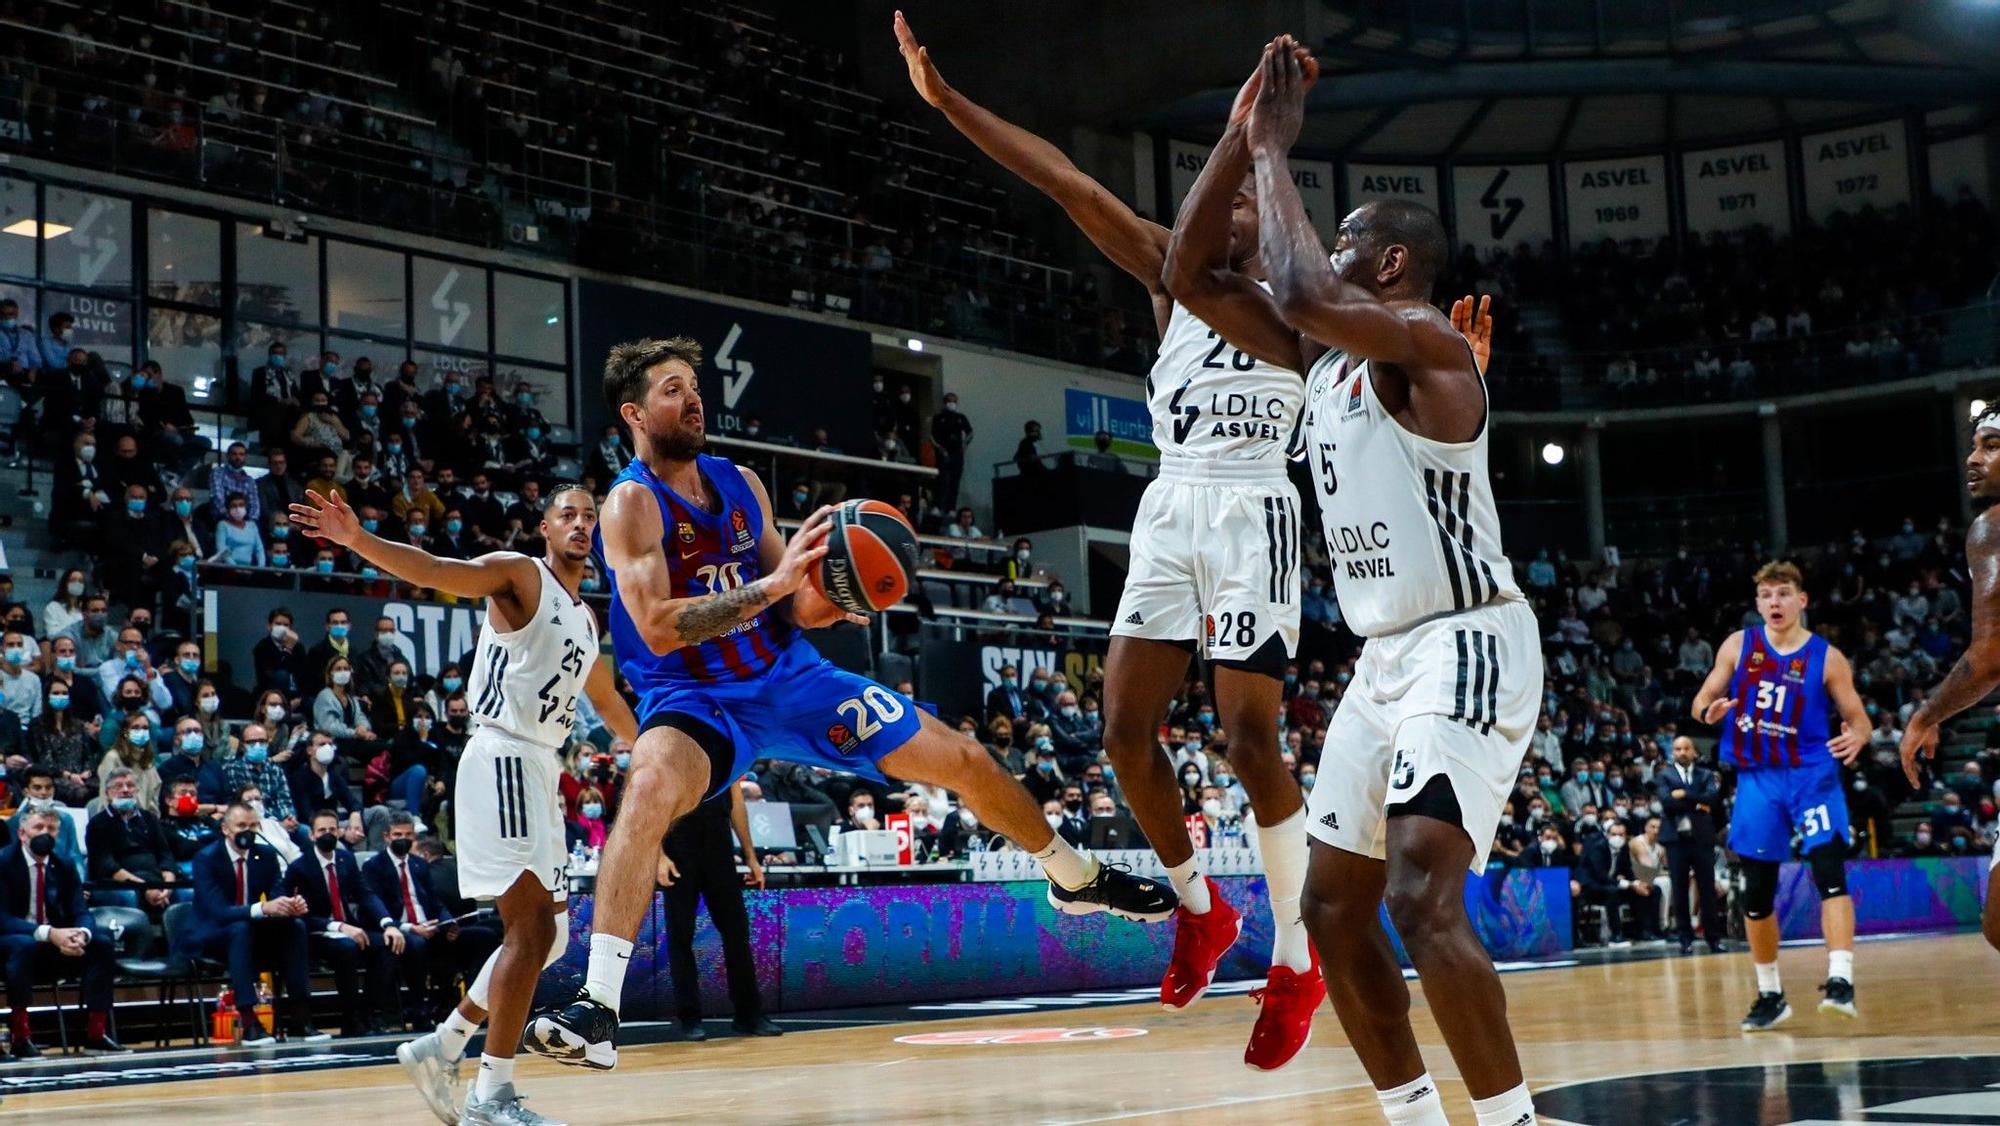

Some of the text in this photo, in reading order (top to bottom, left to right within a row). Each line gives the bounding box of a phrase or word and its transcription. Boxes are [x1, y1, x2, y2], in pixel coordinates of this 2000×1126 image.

[1818, 132, 1892, 162] ASVEL
[1175, 151, 1207, 172] ASV
[1698, 153, 1771, 178] ASVEL
[1292, 171, 1321, 189] VEL
[1361, 175, 1425, 194] ASVEL
[1579, 168, 1651, 190] ASVEL
[1835, 174, 1880, 196] 1972
[1594, 205, 1640, 223] 1969
[1718, 193, 1757, 212] 1971
[70, 296, 117, 317] LDLC
[1211, 393, 1285, 419] LDLC
[717, 413, 743, 432] LDL
[1211, 421, 1279, 441] ASVEL
[1319, 443, 1338, 496] 5
[1330, 521, 1390, 554] LDLC
[1346, 557, 1395, 580] ASVEL
[383, 602, 487, 679] STA
[1219, 611, 1256, 648] 28
[561, 638, 586, 679] 25
[1755, 680, 1787, 713] 31
[836, 685, 905, 742] 20
[1803, 803, 1832, 837] 31
[553, 865, 568, 892] 25
[783, 897, 1042, 991] FORUM
